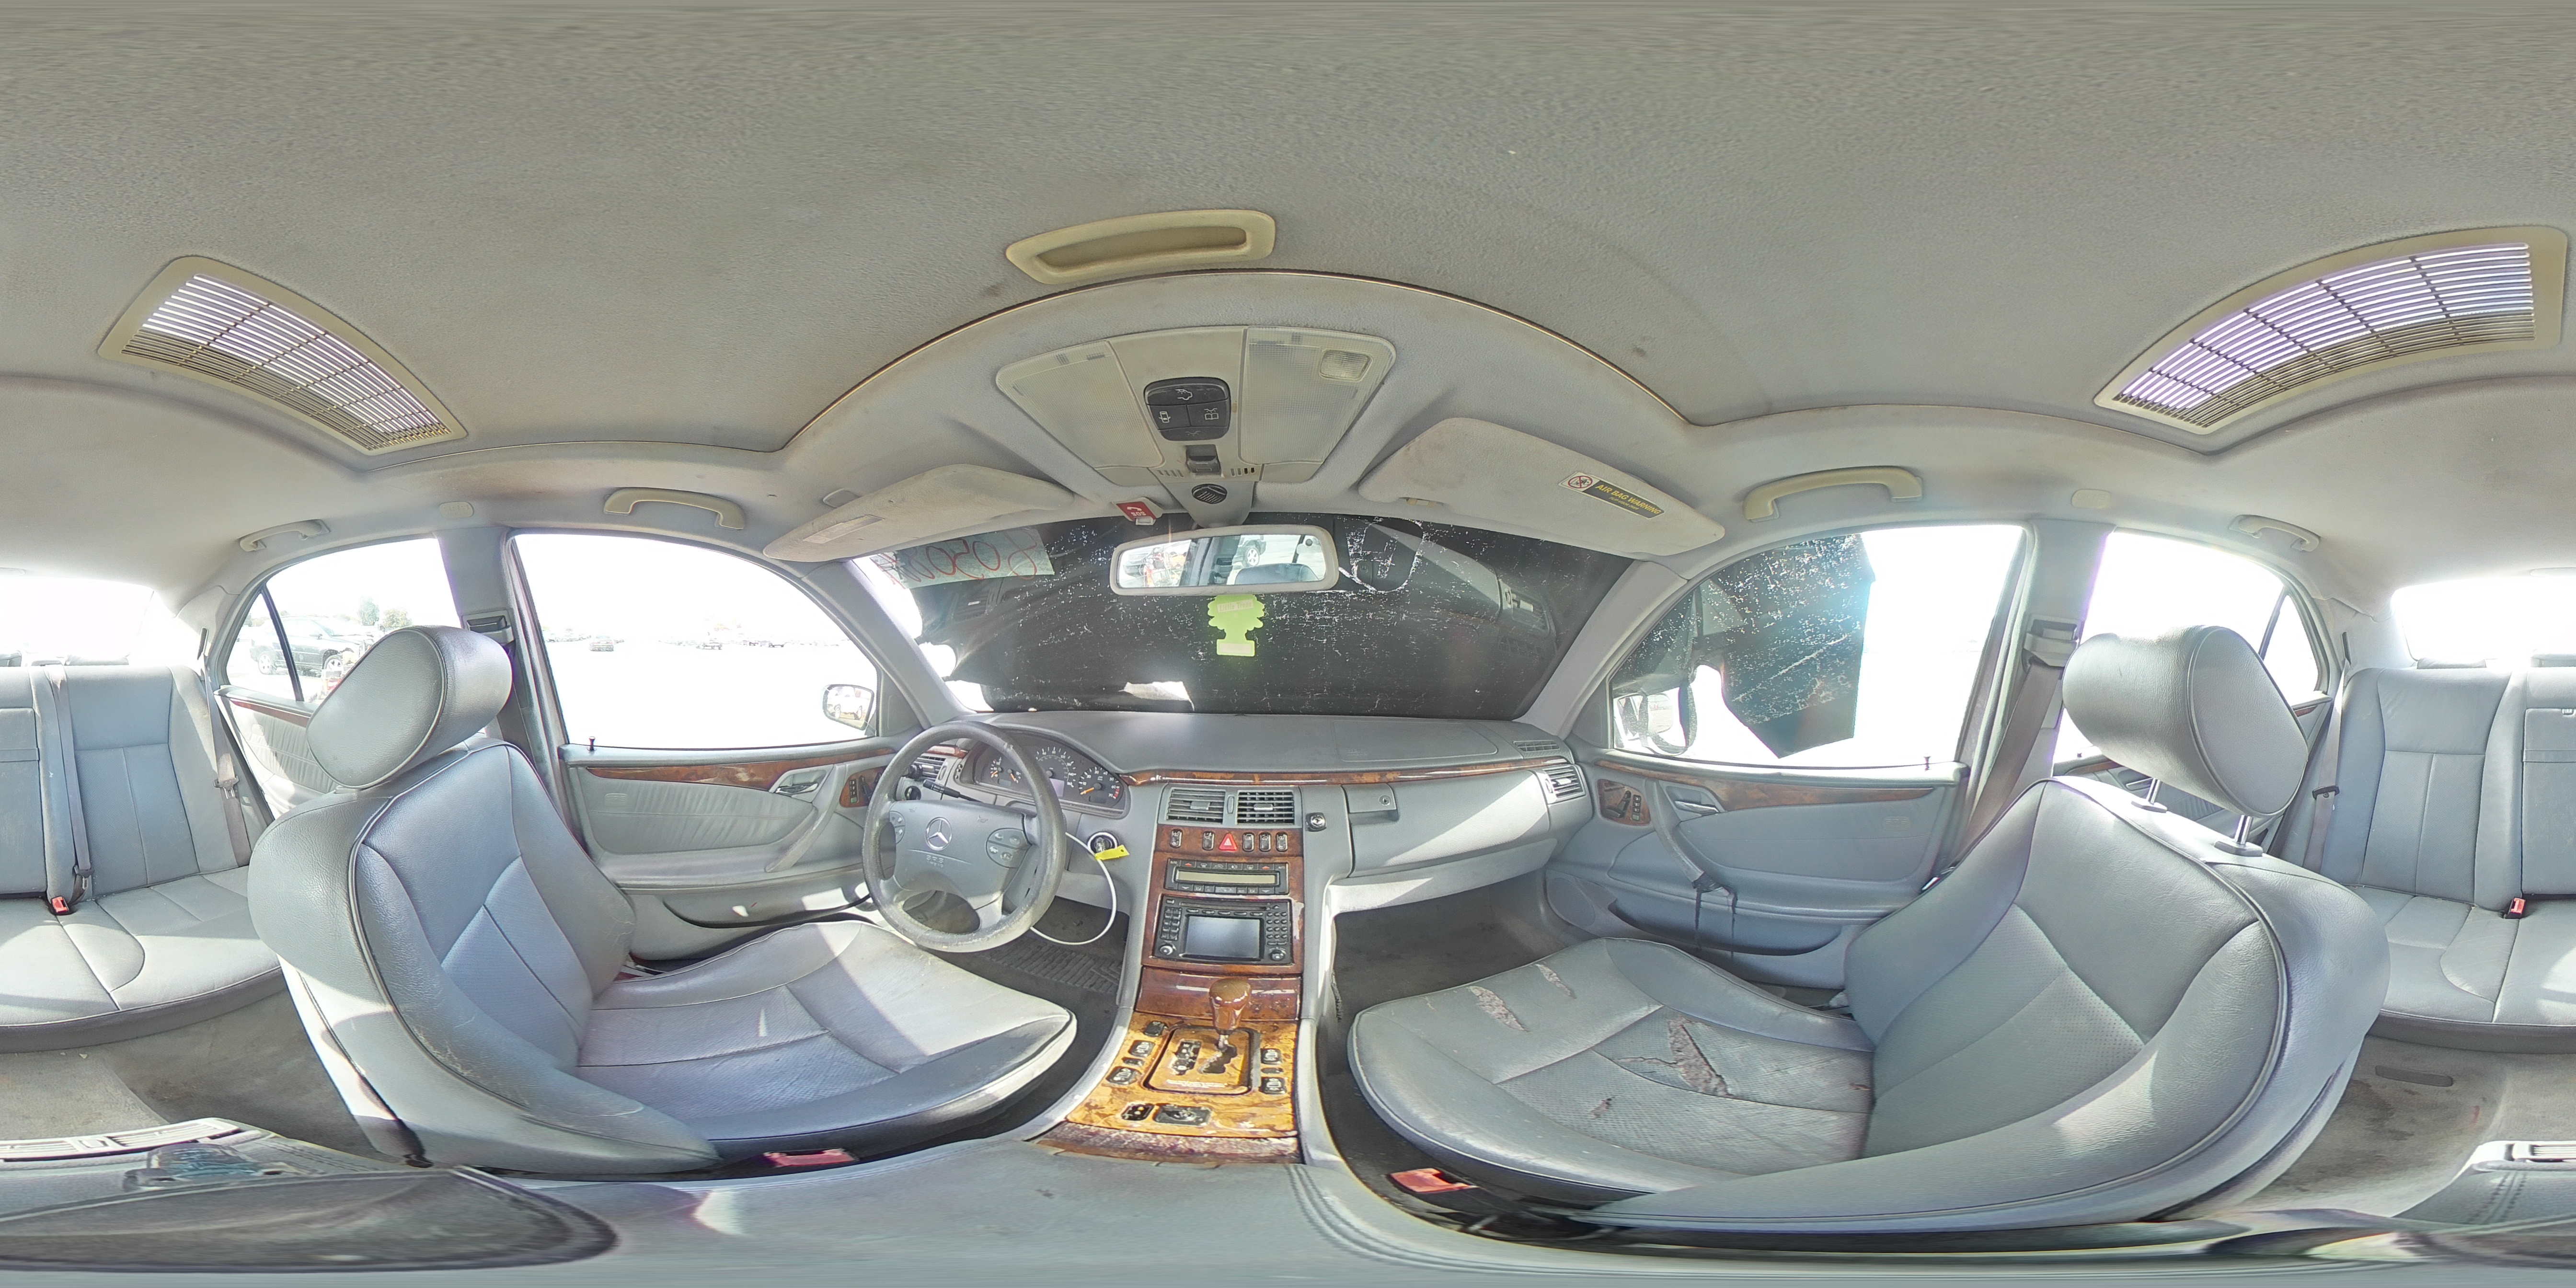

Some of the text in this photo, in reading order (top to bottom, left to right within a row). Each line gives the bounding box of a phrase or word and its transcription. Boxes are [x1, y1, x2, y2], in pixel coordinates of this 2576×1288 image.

[1595, 484, 1661, 514] AIR BAG WARNING
